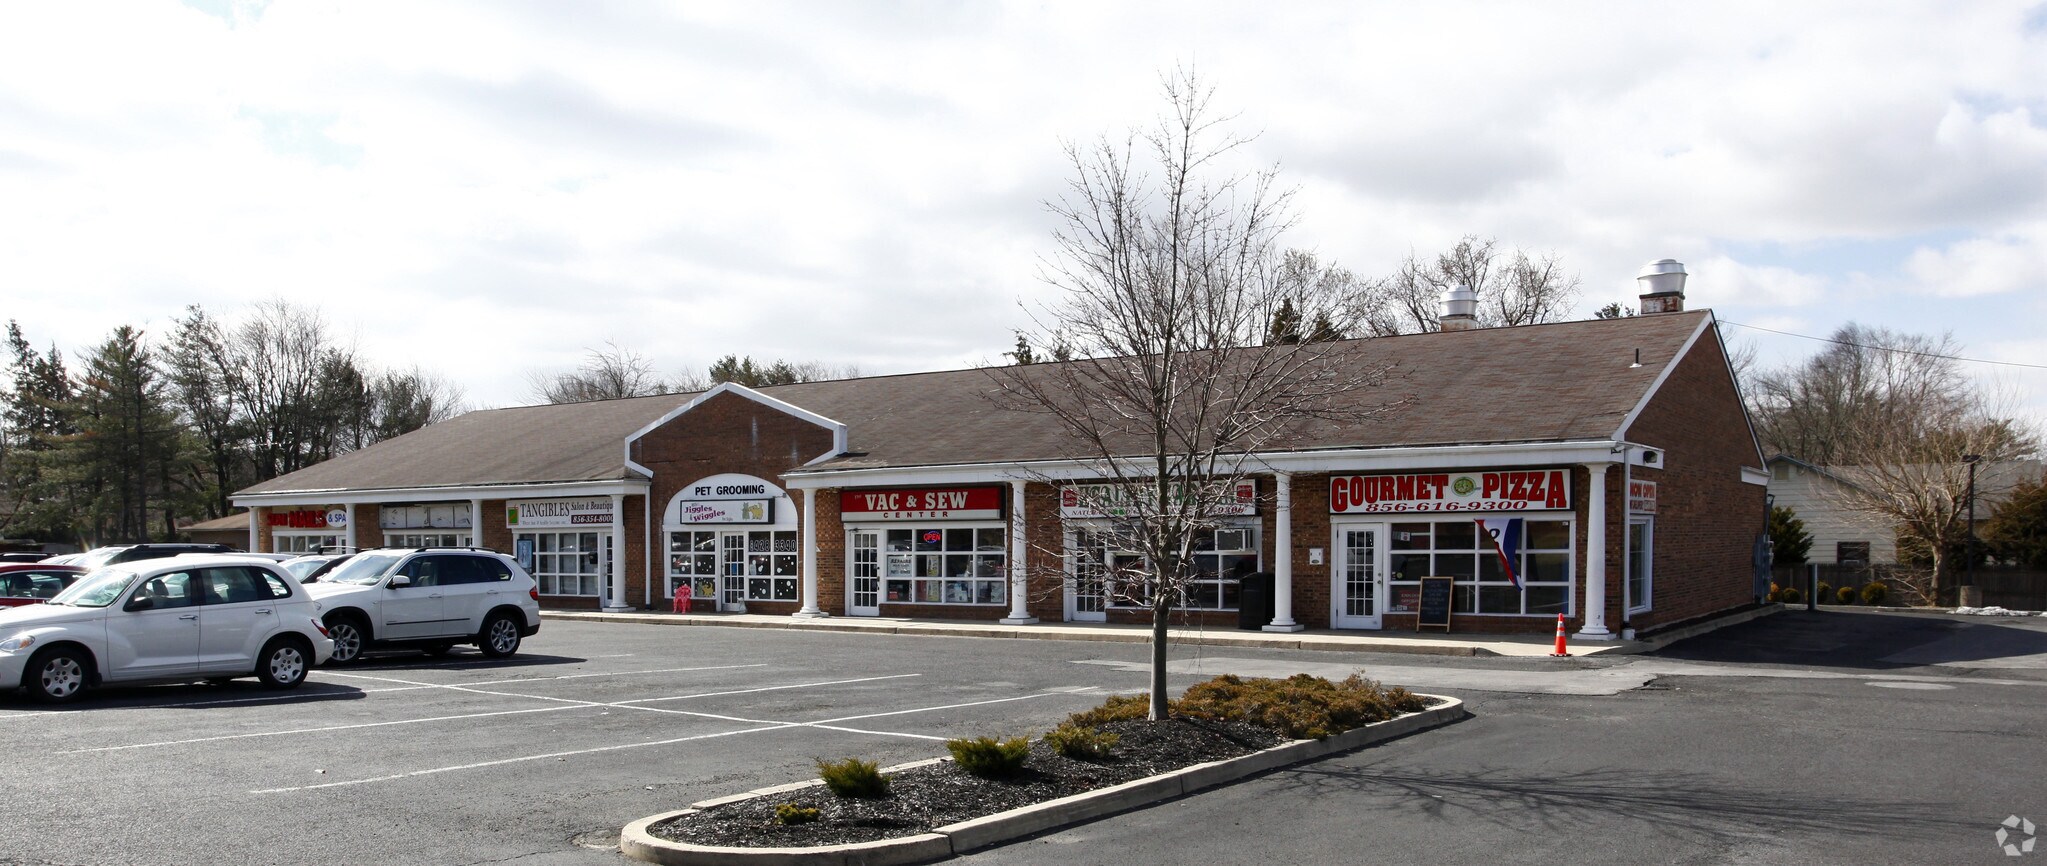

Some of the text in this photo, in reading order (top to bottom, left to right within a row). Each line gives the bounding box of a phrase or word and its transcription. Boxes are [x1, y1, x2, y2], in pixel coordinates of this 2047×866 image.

[695, 485, 765, 496] PET GROOMING
[1331, 471, 1567, 512] GOURMET PIZZA
[571, 502, 585, 511] Salon
[864, 492, 968, 511] VAC & SEW
[1365, 500, 1528, 513] 856-616-9300
[520, 502, 570, 518] TANGIBLES
[684, 505, 713, 514] Jiggles
[884, 511, 948, 519] CENTER
[328, 513, 334, 523] &
[334, 513, 347, 523] SPA
[693, 509, 726, 522] Wiggles
[924, 533, 941, 541] OPEN
